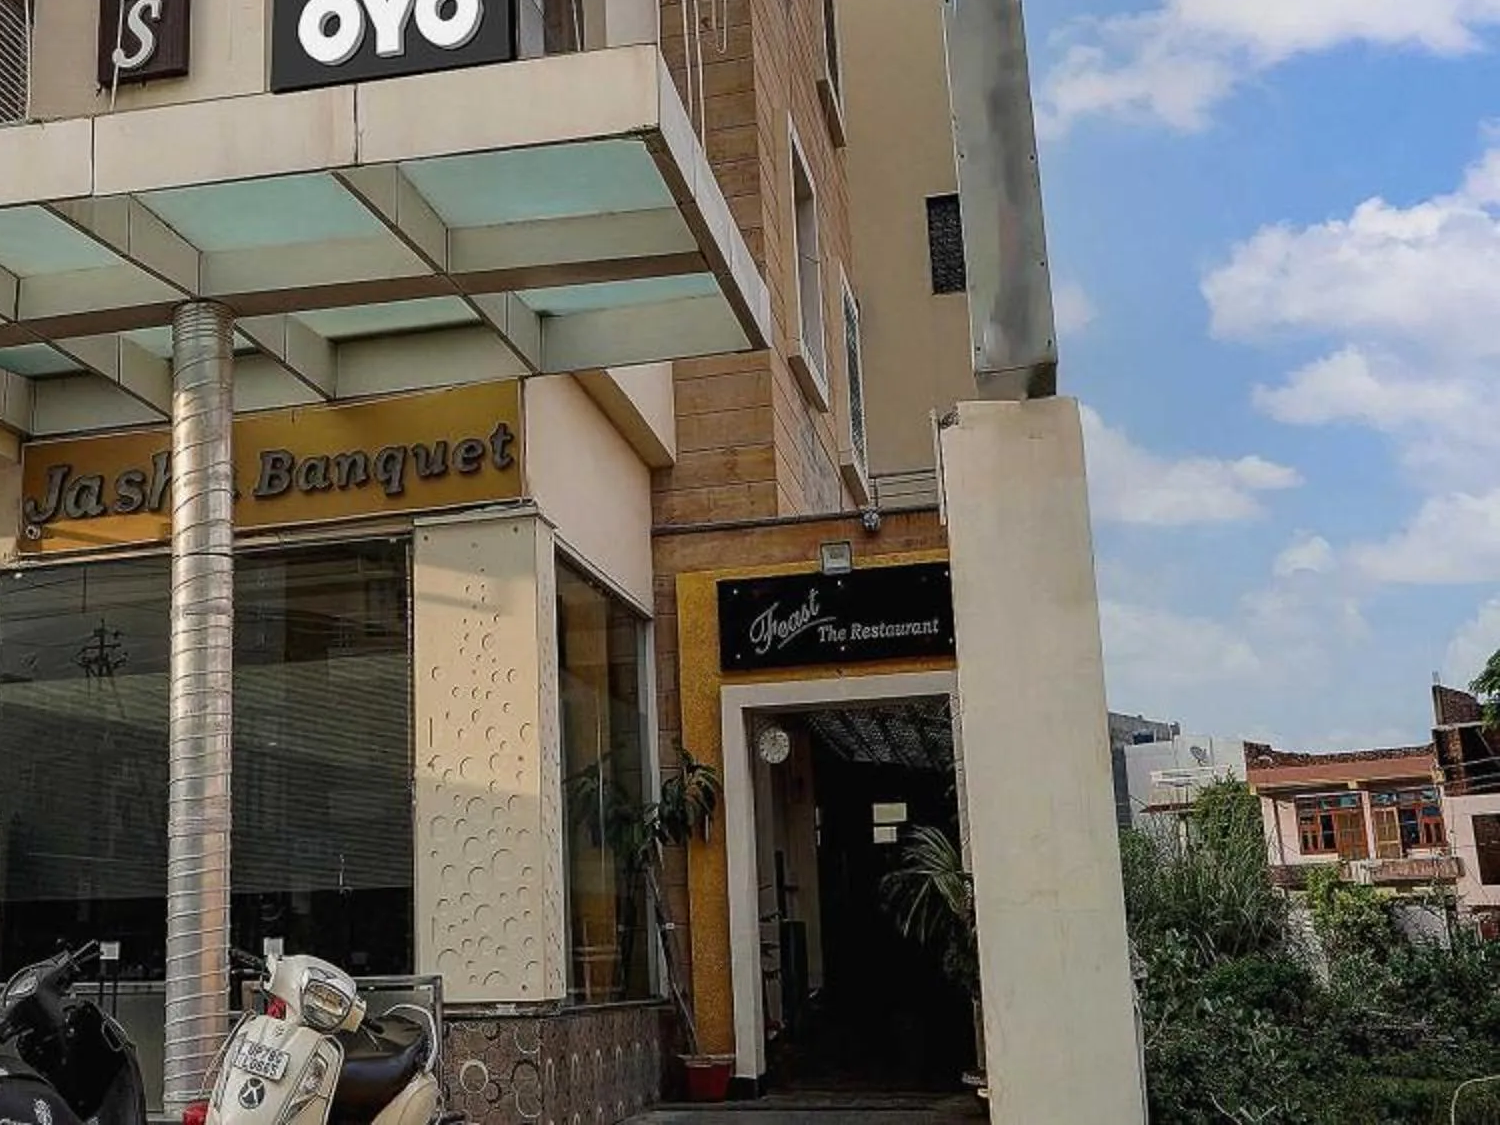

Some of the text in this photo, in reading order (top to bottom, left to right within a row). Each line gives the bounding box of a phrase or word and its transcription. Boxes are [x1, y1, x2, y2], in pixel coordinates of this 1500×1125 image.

[252, 421, 517, 499] Banquet
[750, 587, 820, 655] Feast
[817, 618, 940, 643] The Restaurant
